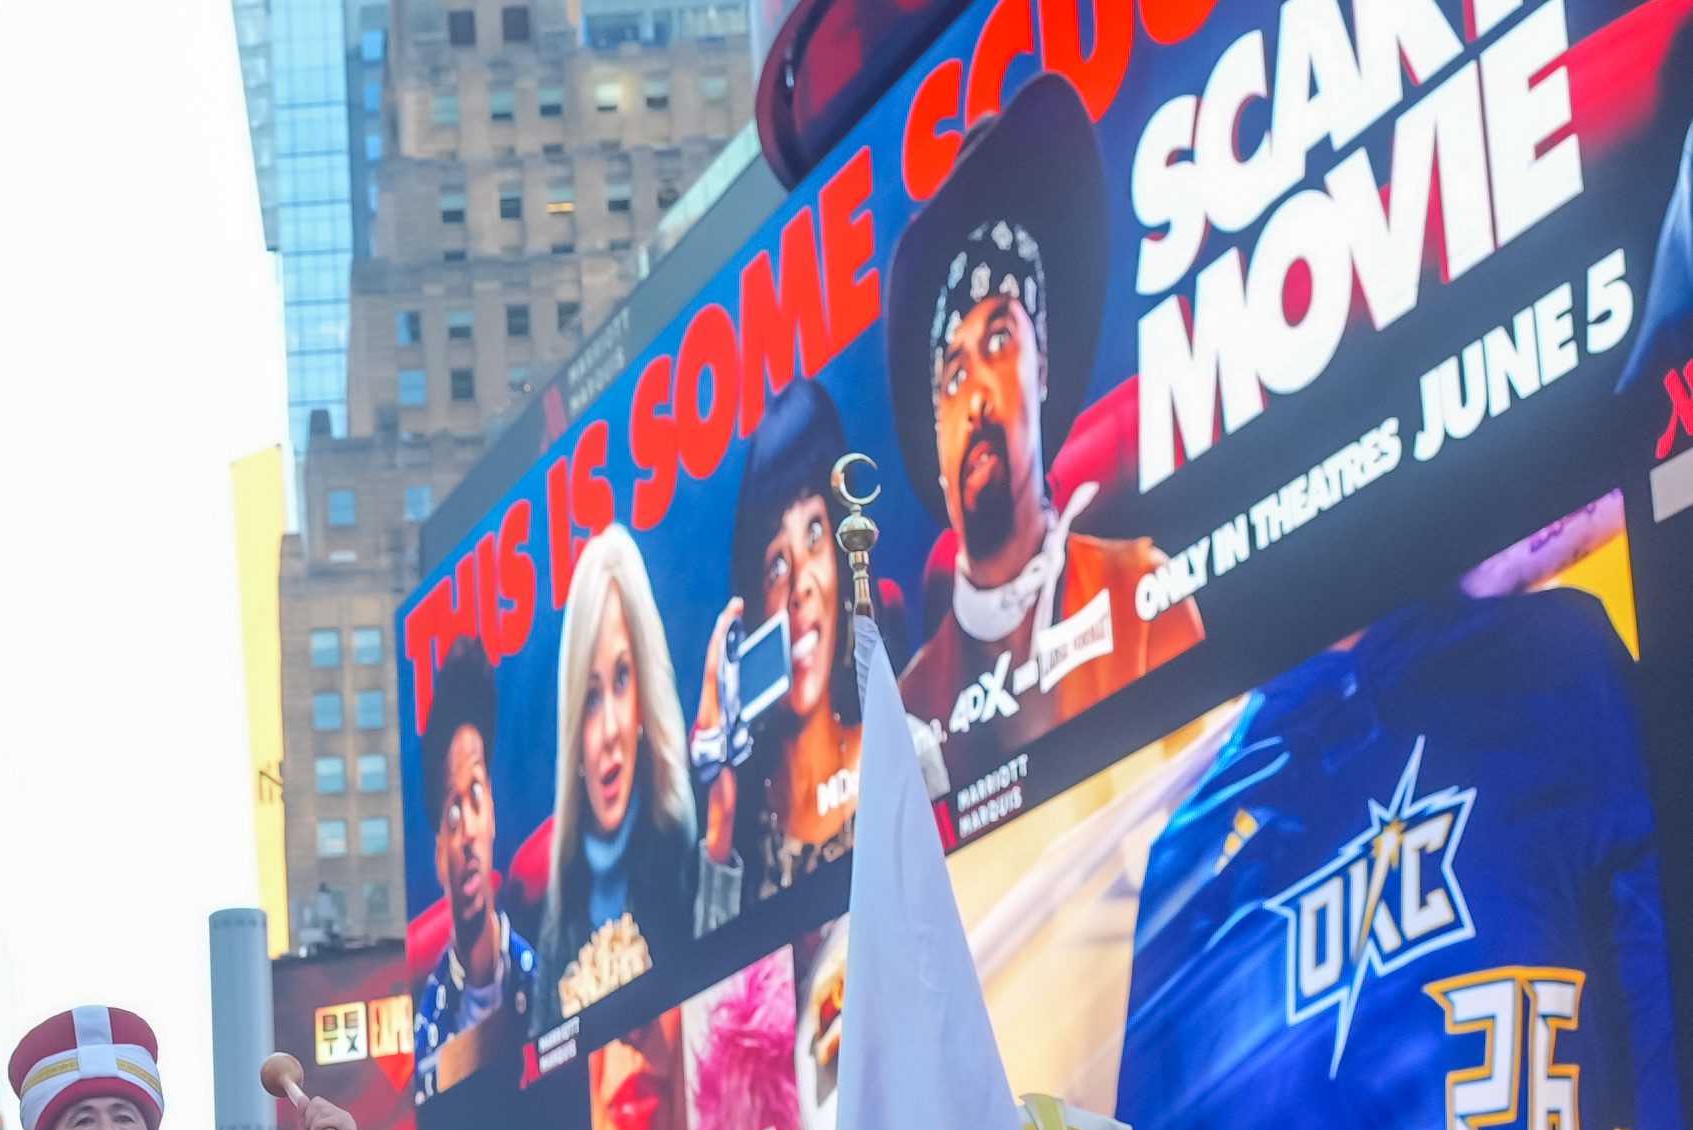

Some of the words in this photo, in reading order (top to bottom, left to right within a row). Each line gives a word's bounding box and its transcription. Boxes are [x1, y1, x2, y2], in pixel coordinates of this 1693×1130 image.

[1131, 0, 1523, 296] SCAR
[1135, 0, 1585, 492] MOVIE
[403, 497, 537, 738] THIS
[546, 419, 614, 611] IS
[629, 144, 882, 532] SOME
[1413, 280, 1579, 462] JUNE
[1587, 249, 1634, 354] 5
[1135, 536, 1210, 621] ONLY
[1211, 513, 1250, 577] IN
[1248, 416, 1402, 551] THEATRES
[957, 753, 1029, 813] MARRIOTT
[1299, 811, 1456, 1000] OKC
